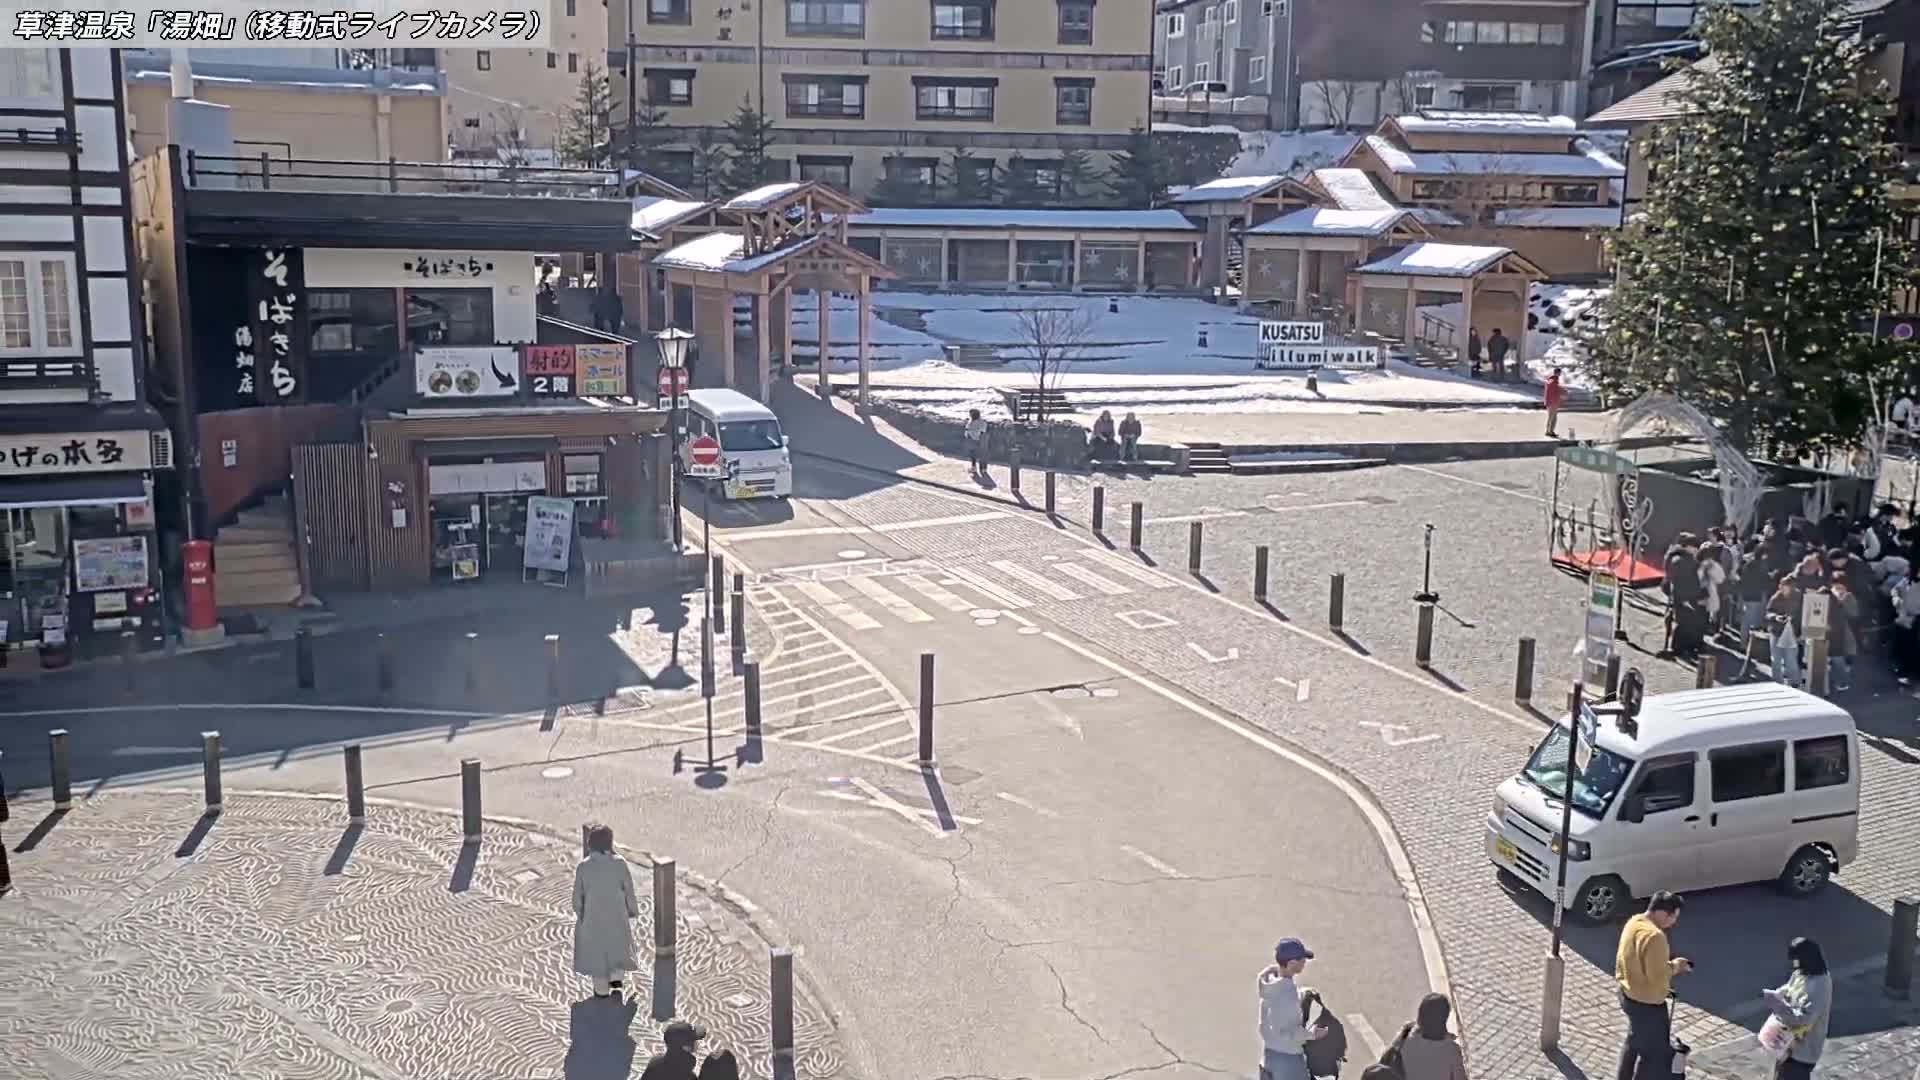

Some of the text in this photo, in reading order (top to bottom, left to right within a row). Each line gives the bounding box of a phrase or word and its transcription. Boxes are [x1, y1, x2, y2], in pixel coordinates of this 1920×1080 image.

[259, 250, 296, 396] そばきち
[1262, 324, 1320, 341] KUSATSU
[530, 349, 570, 371] 射的
[1271, 350, 1375, 362] illumiwalk
[0, 438, 124, 468] げの本多
